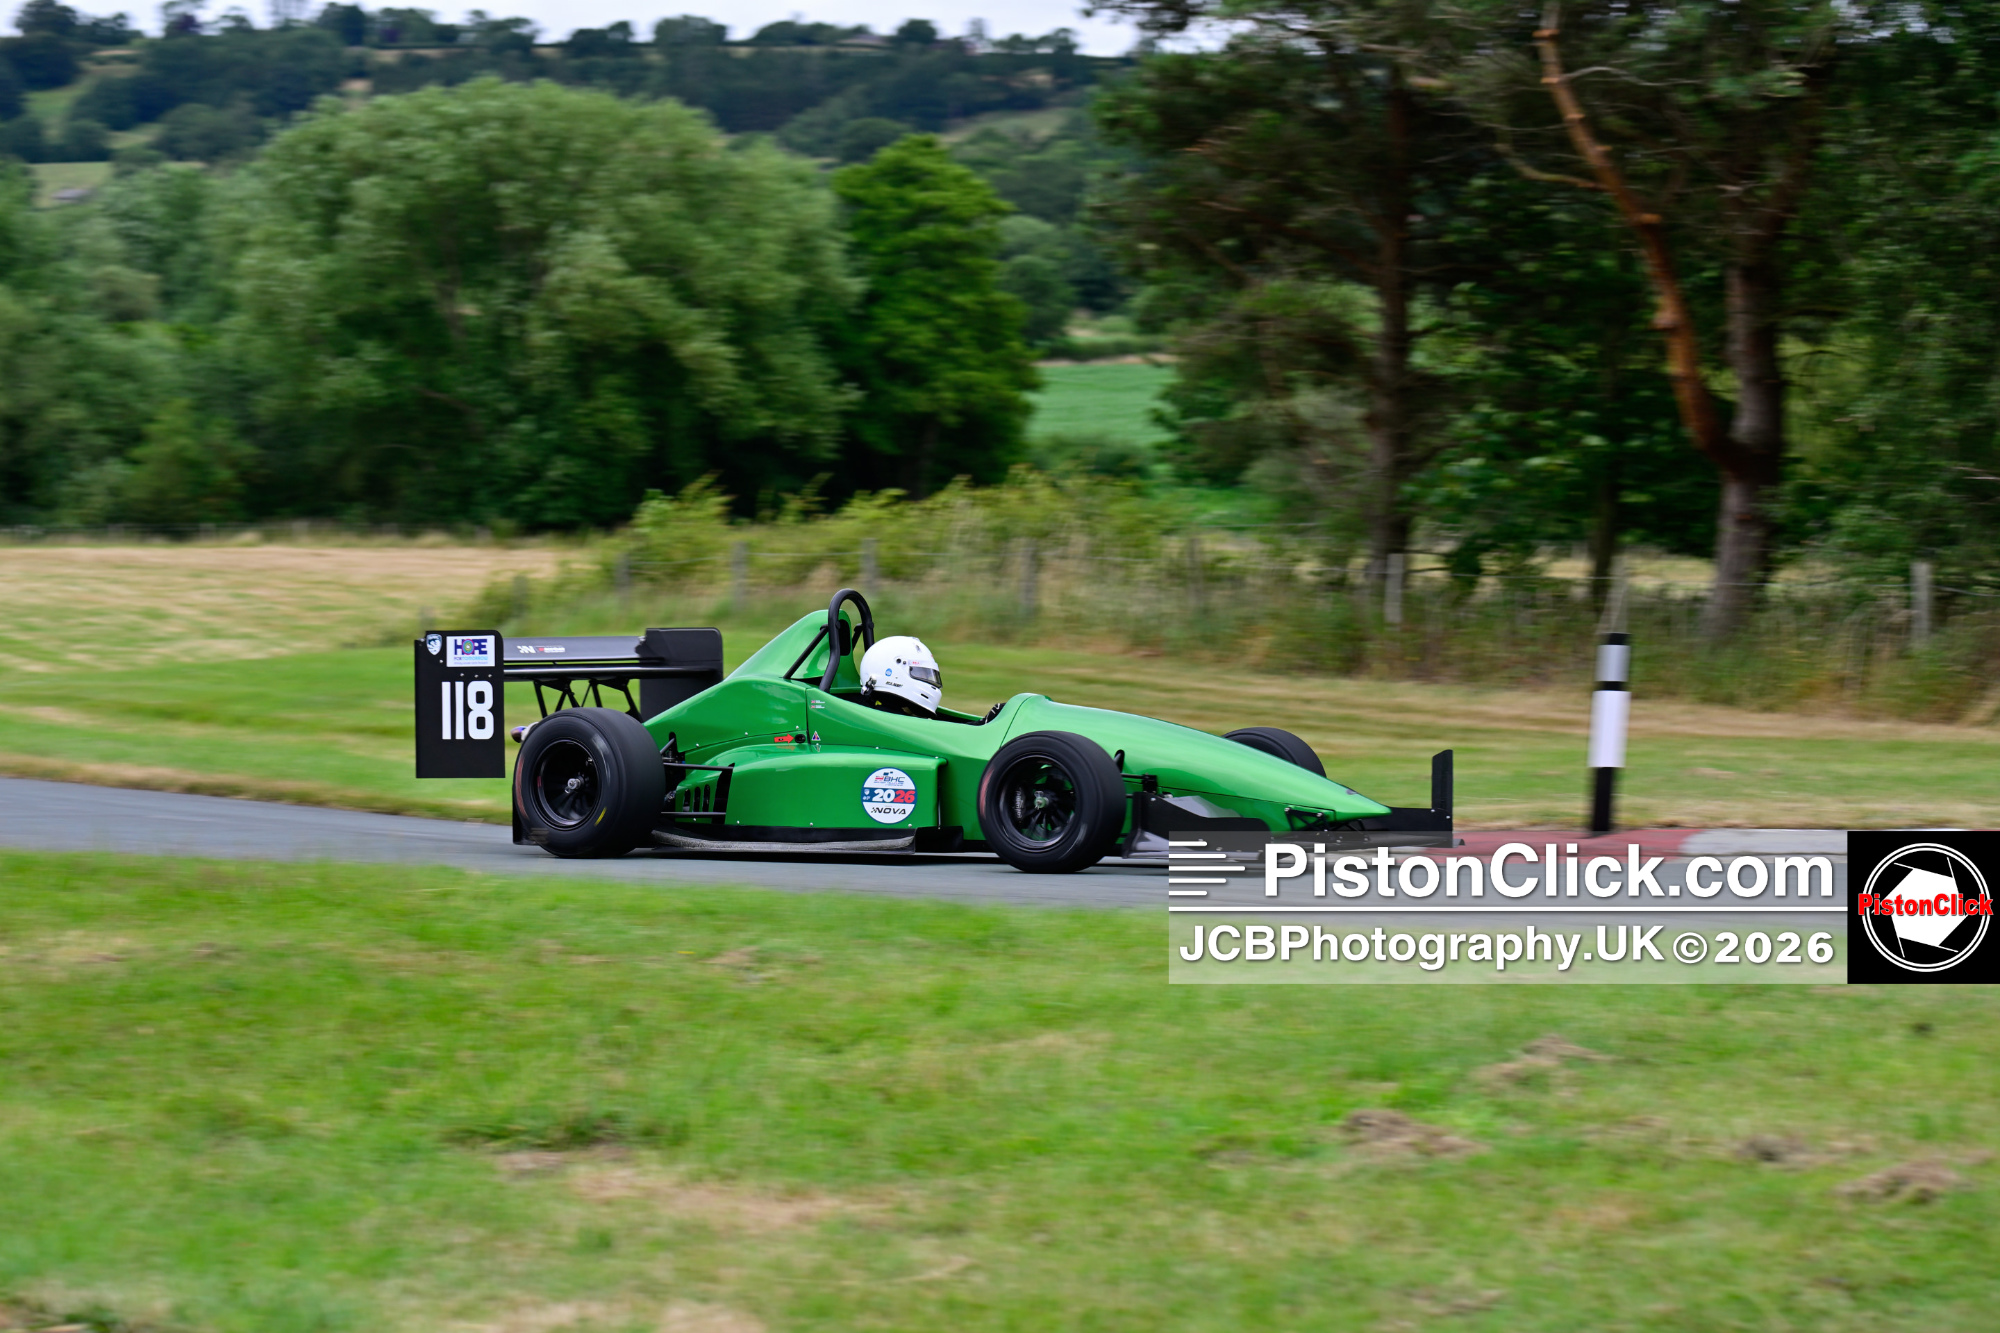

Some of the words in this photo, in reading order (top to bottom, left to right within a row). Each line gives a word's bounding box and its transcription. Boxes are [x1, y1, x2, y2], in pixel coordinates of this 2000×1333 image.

[441, 680, 494, 740] 118
[872, 788, 916, 804] 2026
[875, 807, 907, 815] NOVA
